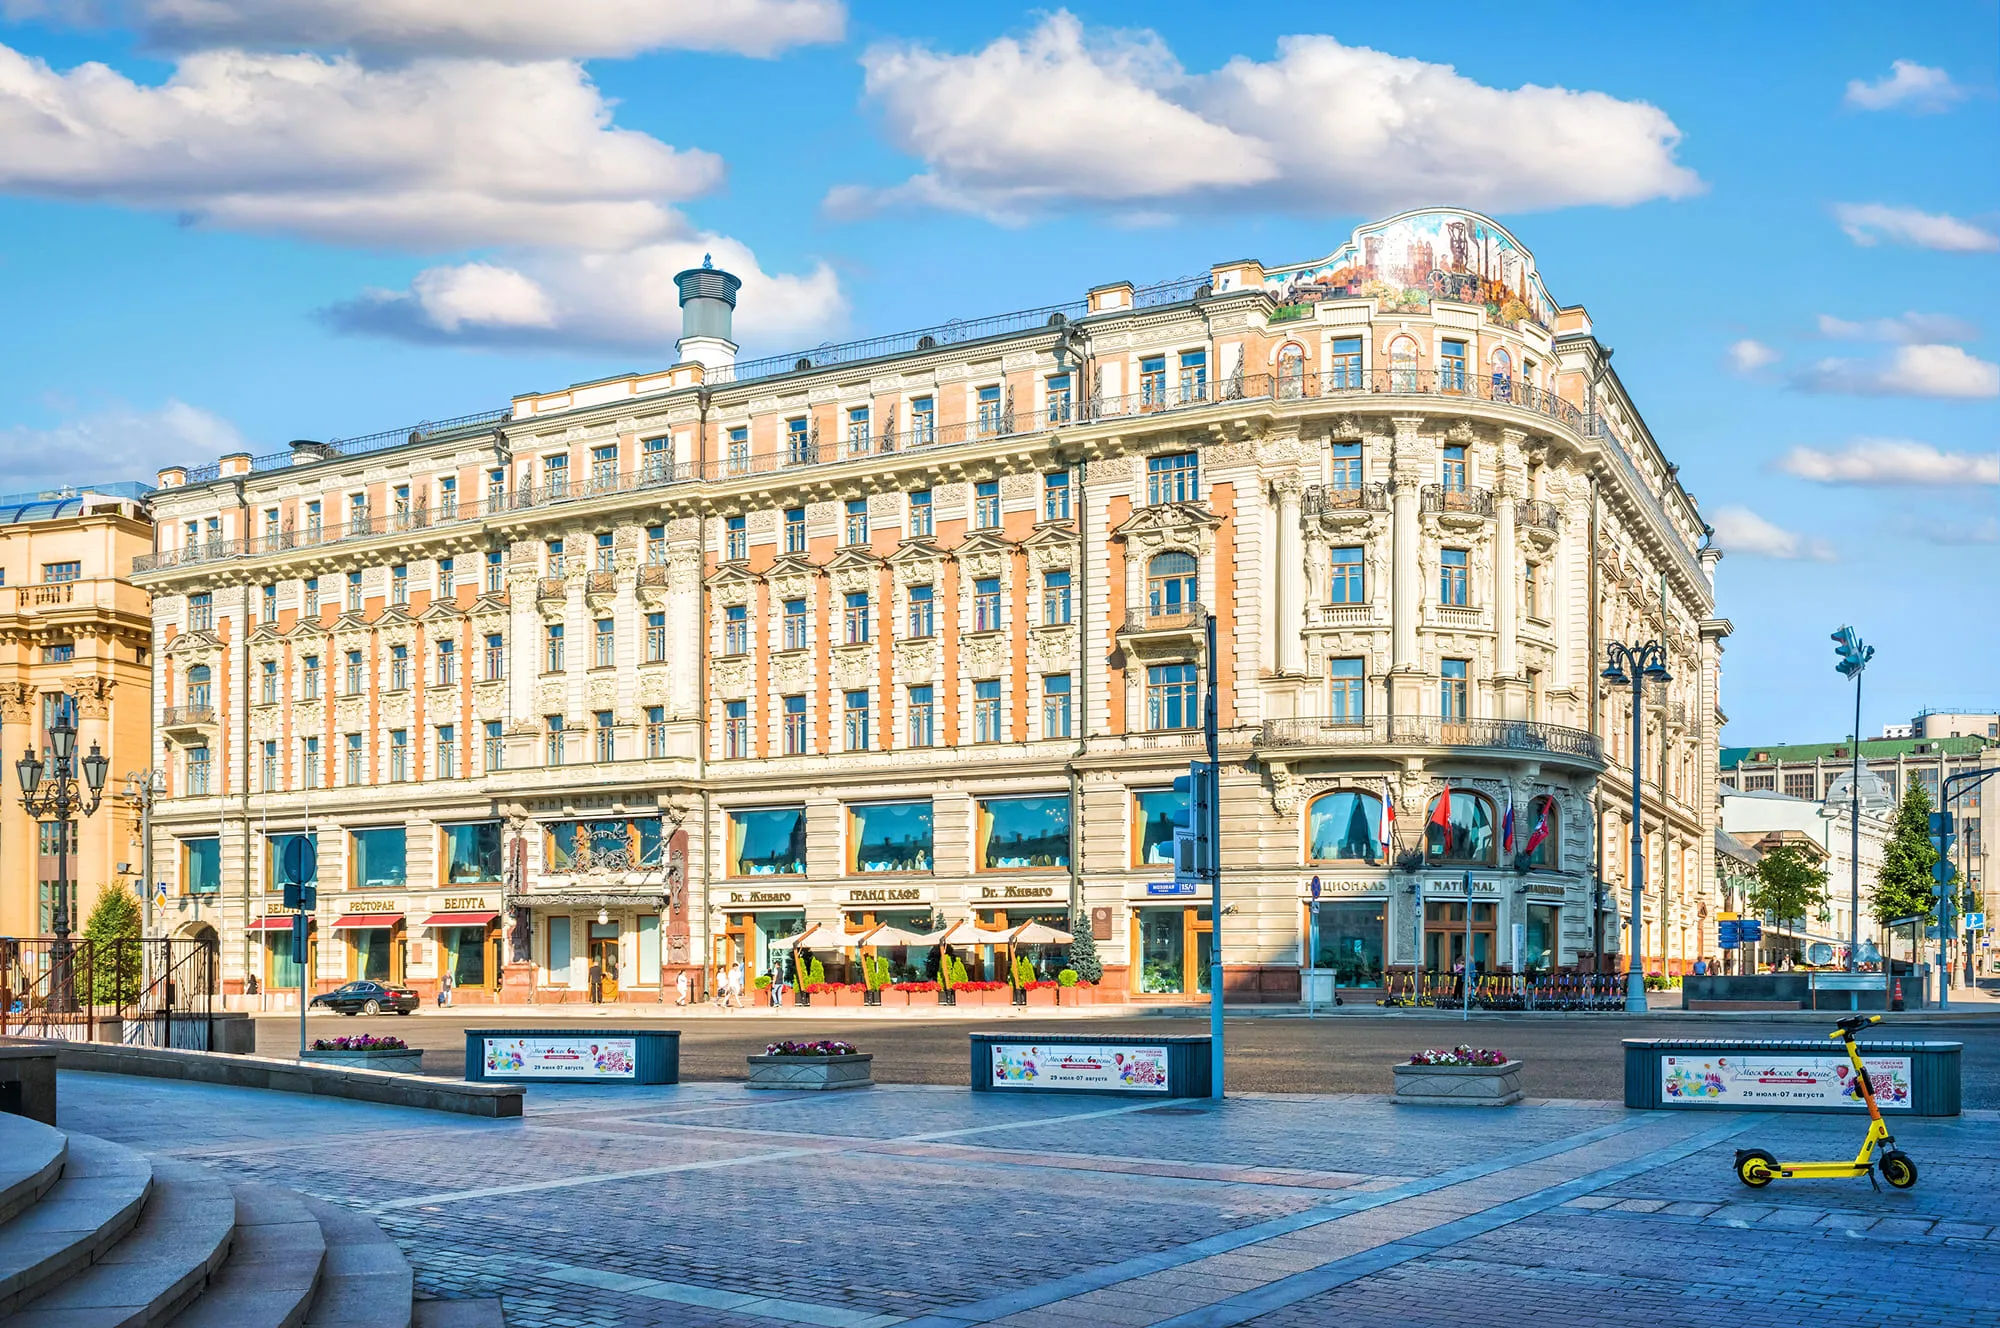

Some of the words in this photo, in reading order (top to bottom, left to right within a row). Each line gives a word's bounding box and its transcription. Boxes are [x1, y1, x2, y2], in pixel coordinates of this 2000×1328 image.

[982, 886, 998, 898] Dr.
[1004, 886, 1053, 898] Живаго
[1305, 881, 1386, 893] НЦИОНАЛЬ
[1433, 881, 1495, 892] NATINAL
[731, 892, 744, 903] Dr.
[750, 891, 791, 902] Живаго
[850, 889, 886, 902] ГРАНД
[888, 888, 920, 900] КАФЕ
[350, 900, 394, 912] РЕСТОРАН
[444, 897, 485, 910] БЕЛУГА
[1793, 1091, 1825, 1100] августа
